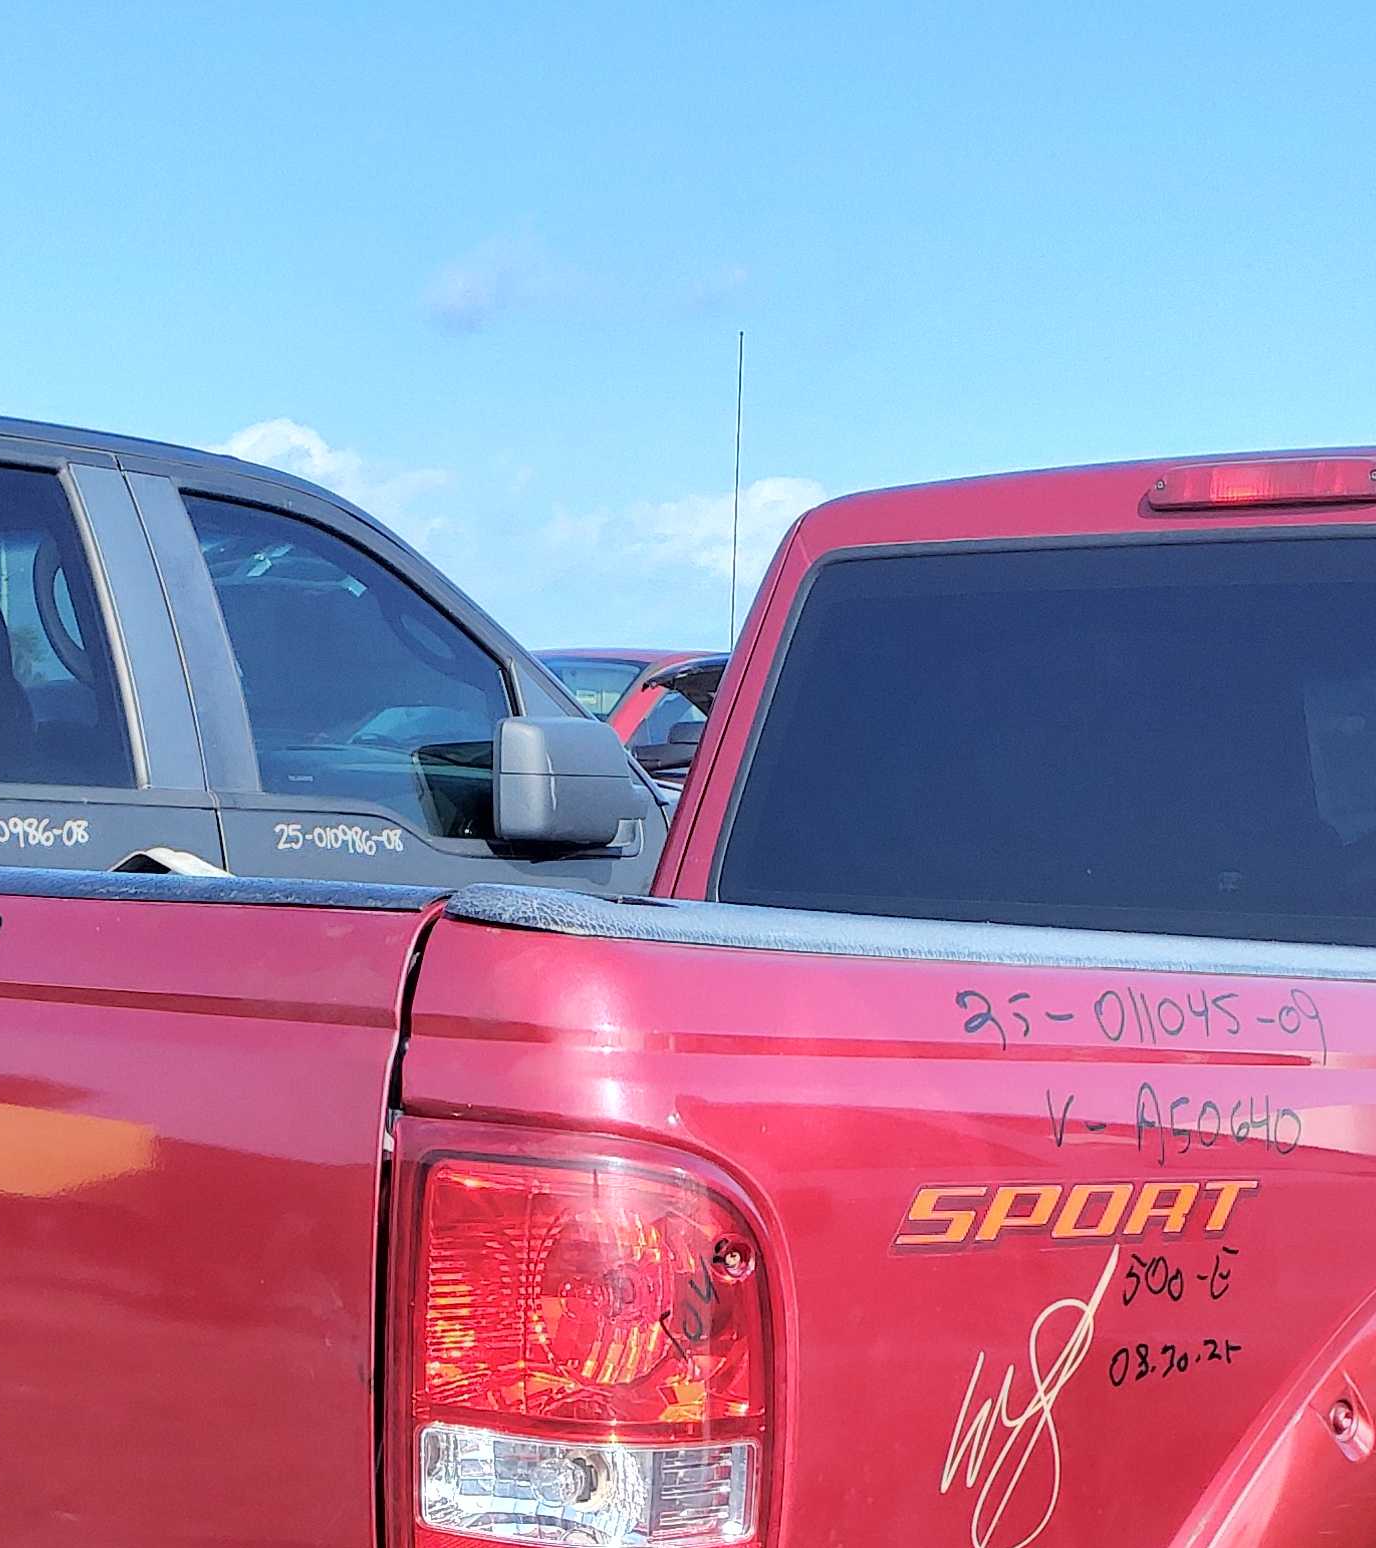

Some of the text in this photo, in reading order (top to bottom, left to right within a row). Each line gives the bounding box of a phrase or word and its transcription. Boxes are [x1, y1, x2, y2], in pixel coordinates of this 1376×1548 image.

[274, 822, 405, 856] 25-010986-08
[954, 987, 1328, 1066] 25-011045-09
[889, 1178, 1260, 1256] SPORT
